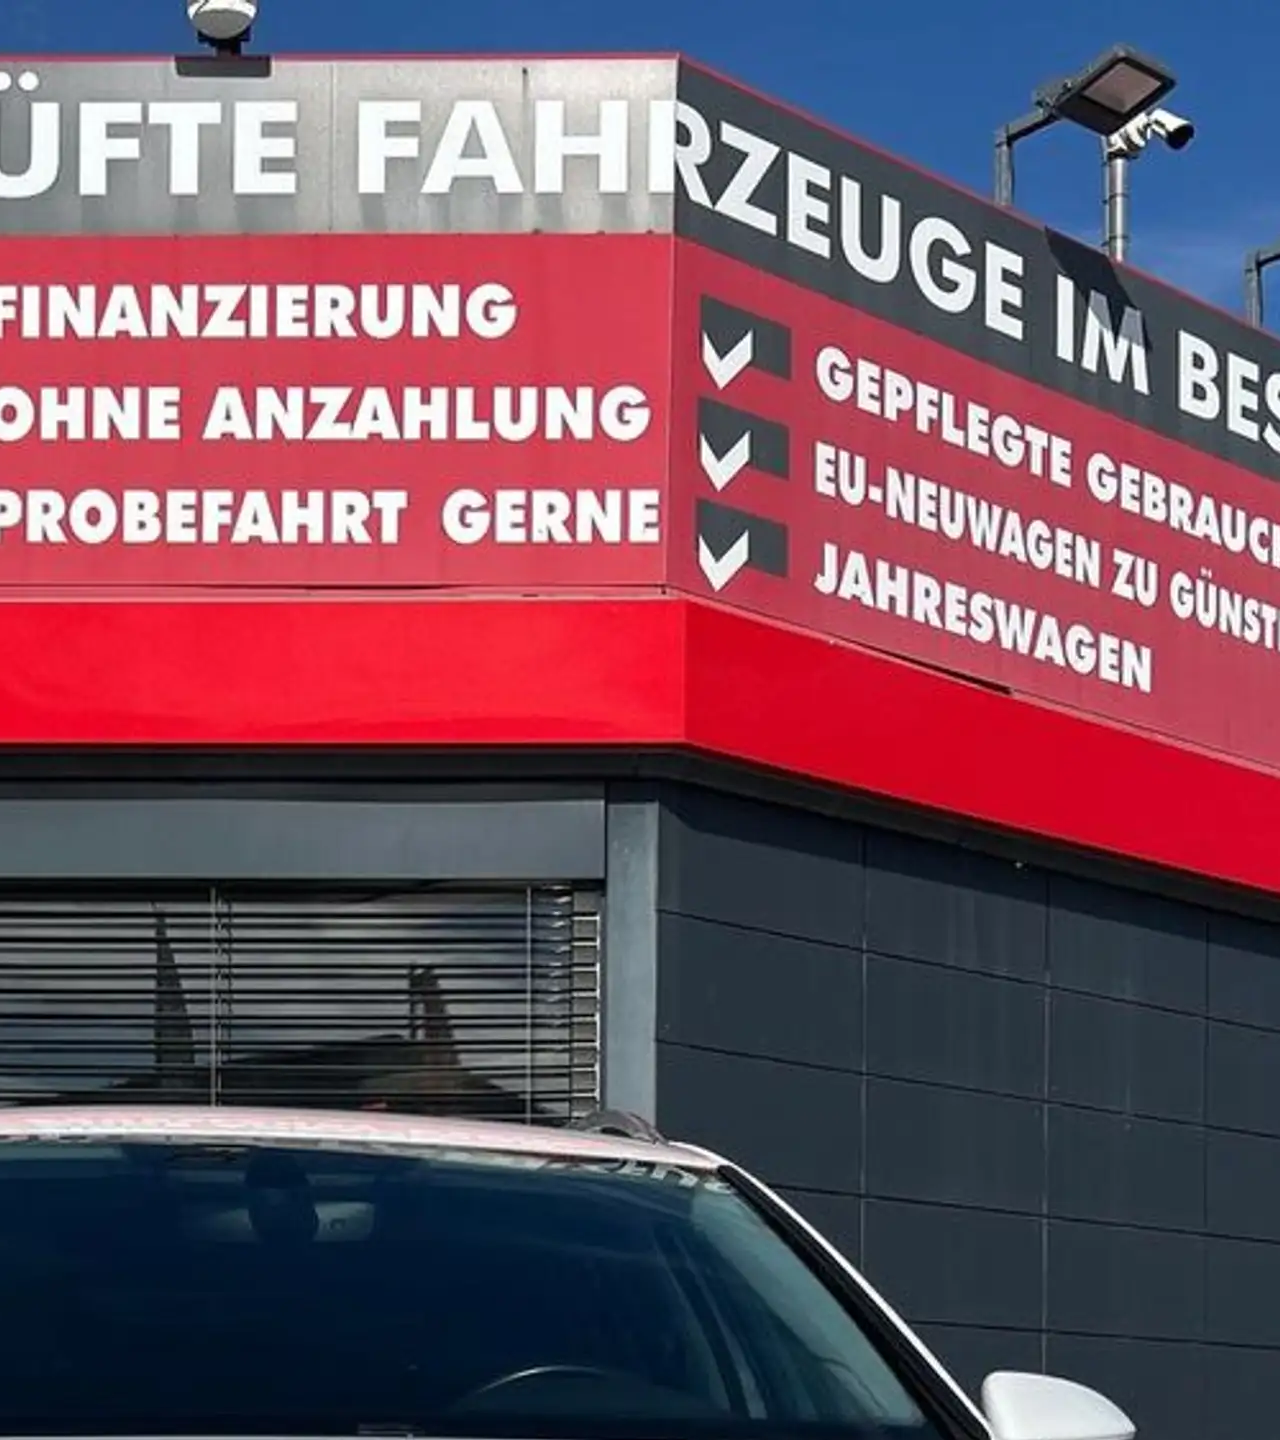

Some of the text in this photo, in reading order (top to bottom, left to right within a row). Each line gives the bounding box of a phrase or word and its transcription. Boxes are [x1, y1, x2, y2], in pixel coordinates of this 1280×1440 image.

[357, 98, 1025, 342] FAHRZEUGE
[1056, 276, 1151, 395] IM
[204, 386, 651, 442] ANZAHLUNG
[816, 346, 1072, 488] GEPFLEGTE
[442, 489, 660, 544] GERNE
[815, 442, 1102, 590] EU-NEUWAGEN
[1112, 549, 1157, 607] ZU
[814, 543, 1151, 693] JAHRESWAGEN
